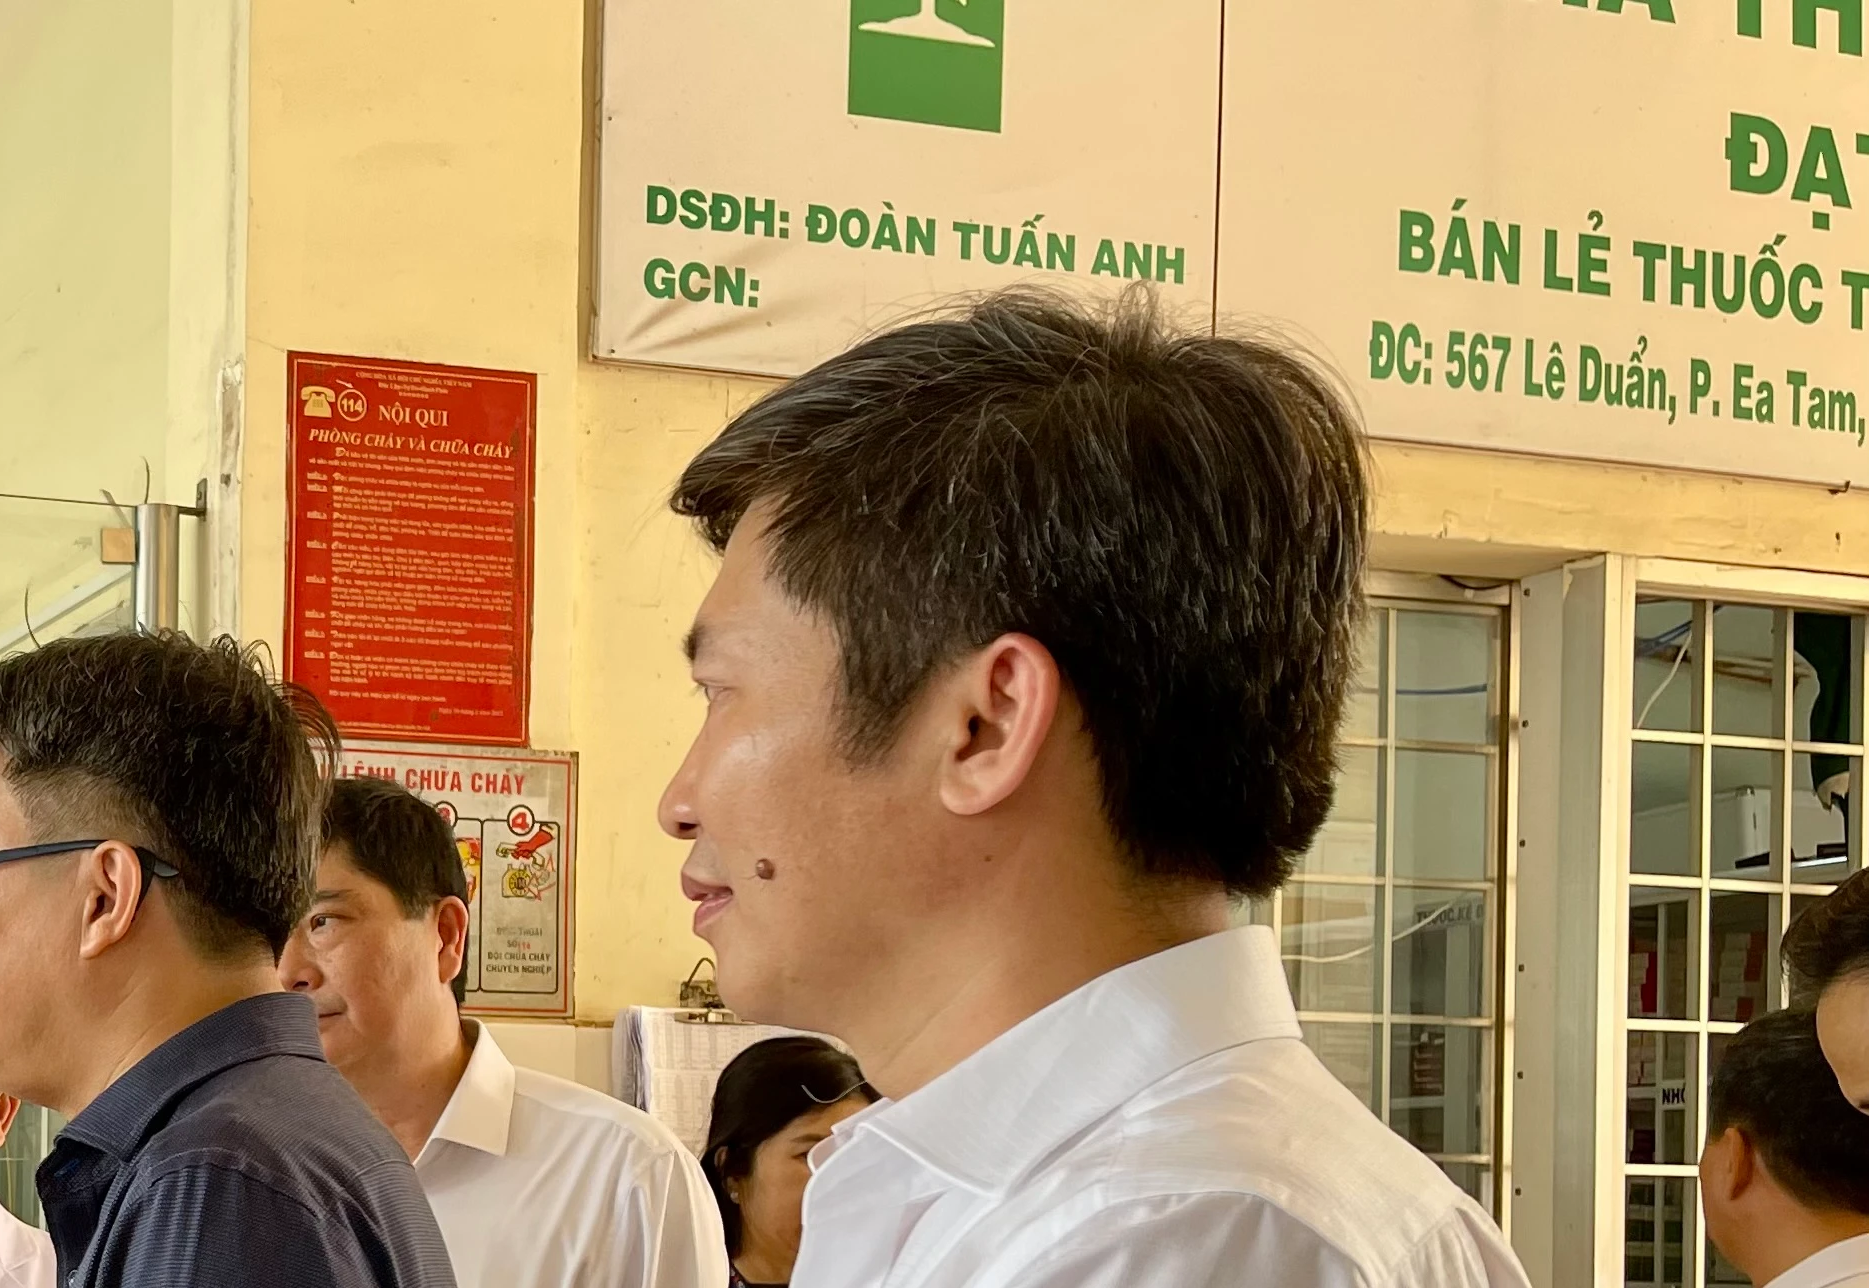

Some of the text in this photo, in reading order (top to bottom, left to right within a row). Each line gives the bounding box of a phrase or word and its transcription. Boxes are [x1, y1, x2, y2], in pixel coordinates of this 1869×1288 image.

[645, 184, 1187, 285] DSĐH: ĐOÀN TUẤN ANH
[1397, 197, 1522, 285] BÁN
[1543, 210, 1612, 297] LẺ
[1631, 234, 1824, 325] THUỐC
[642, 257, 761, 309] GCN:
[1368, 320, 1866, 447] ĐC: 567 Lê Duẩn, P. Ea Tam,
[341, 397, 364, 414] 114
[378, 401, 449, 428] NỘI QUI
[308, 427, 515, 459] PHÒNG CHÁY VÀ CHỮA CHÁY
[404, 765, 463, 793] CHỮA
[470, 767, 527, 796] CHÁY
[510, 811, 531, 832] 4
